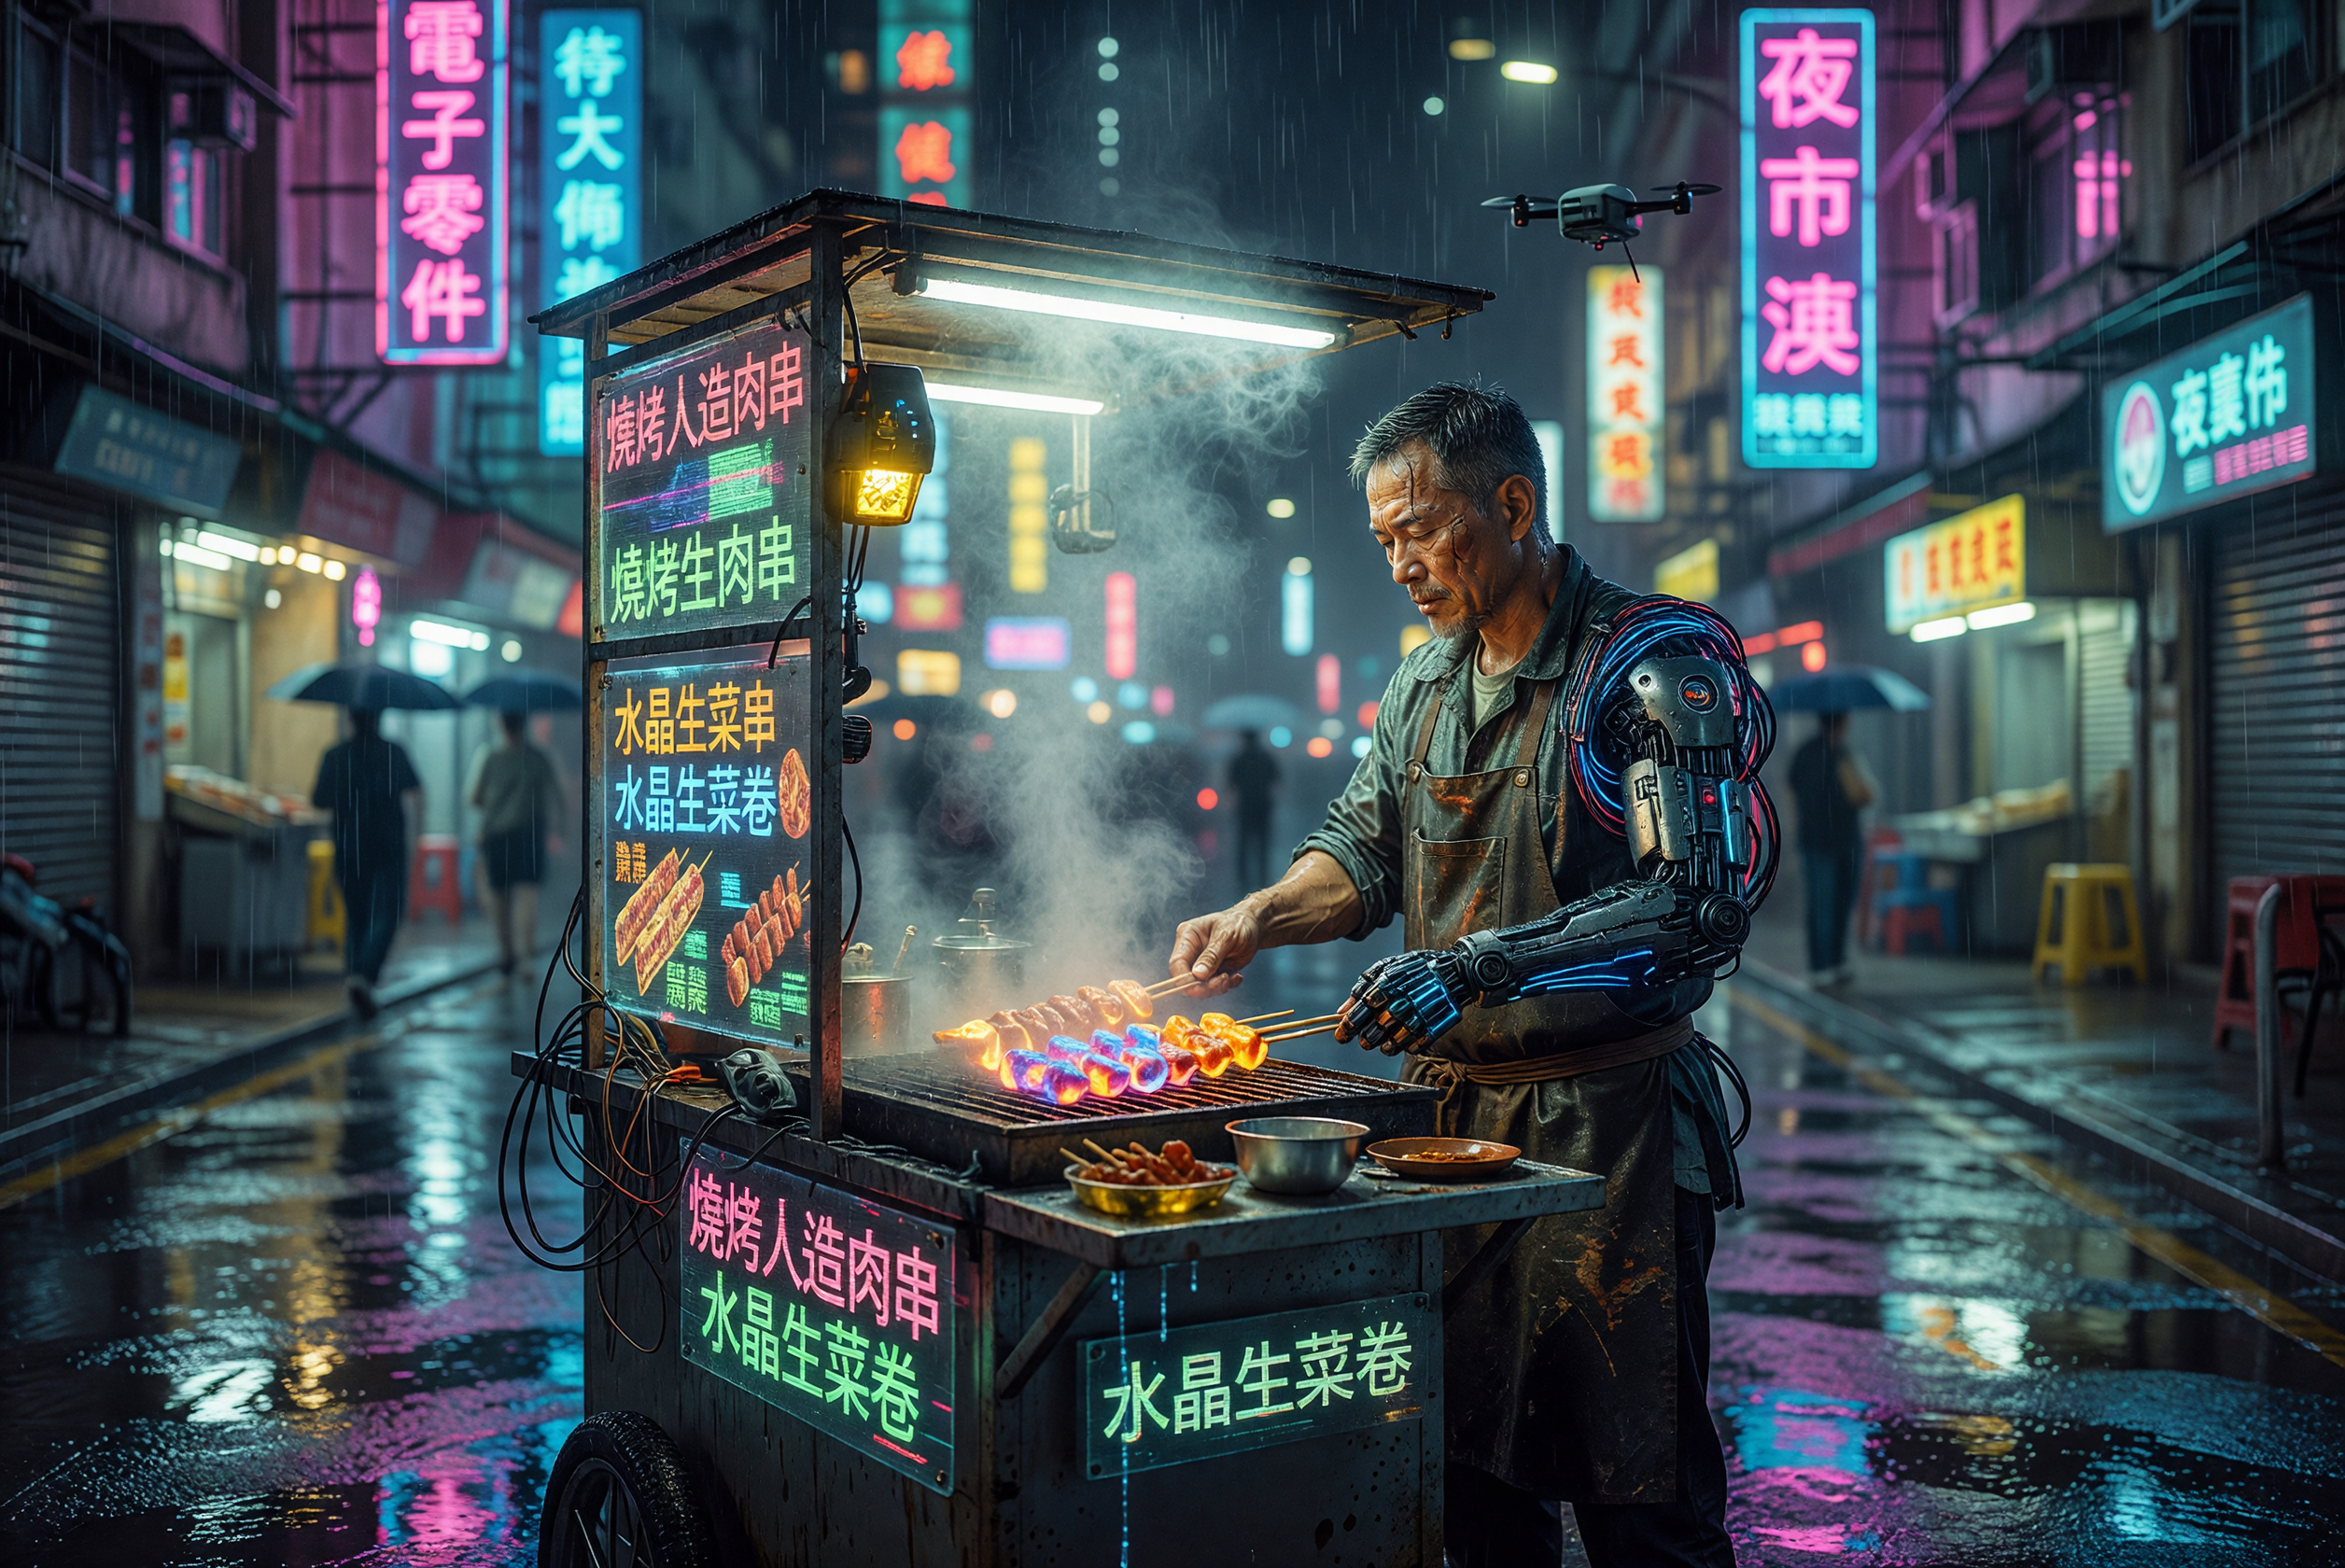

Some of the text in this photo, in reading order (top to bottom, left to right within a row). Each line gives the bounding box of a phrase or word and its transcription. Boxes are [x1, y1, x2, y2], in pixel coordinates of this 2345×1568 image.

[400, 1, 485, 343] 電子零件
[607, 341, 804, 473] 燒烤人造肉串
[611, 515, 795, 623] 燒烤生肉串
[614, 679, 776, 755] 水晶生菜串
[614, 763, 777, 837] 水晶生菜卷
[689, 1168, 938, 1341] 燒烤人造肉串
[701, 1270, 920, 1443] 水晶生菜卷
[1102, 1321, 1412, 1443] 水晶生菜卷
